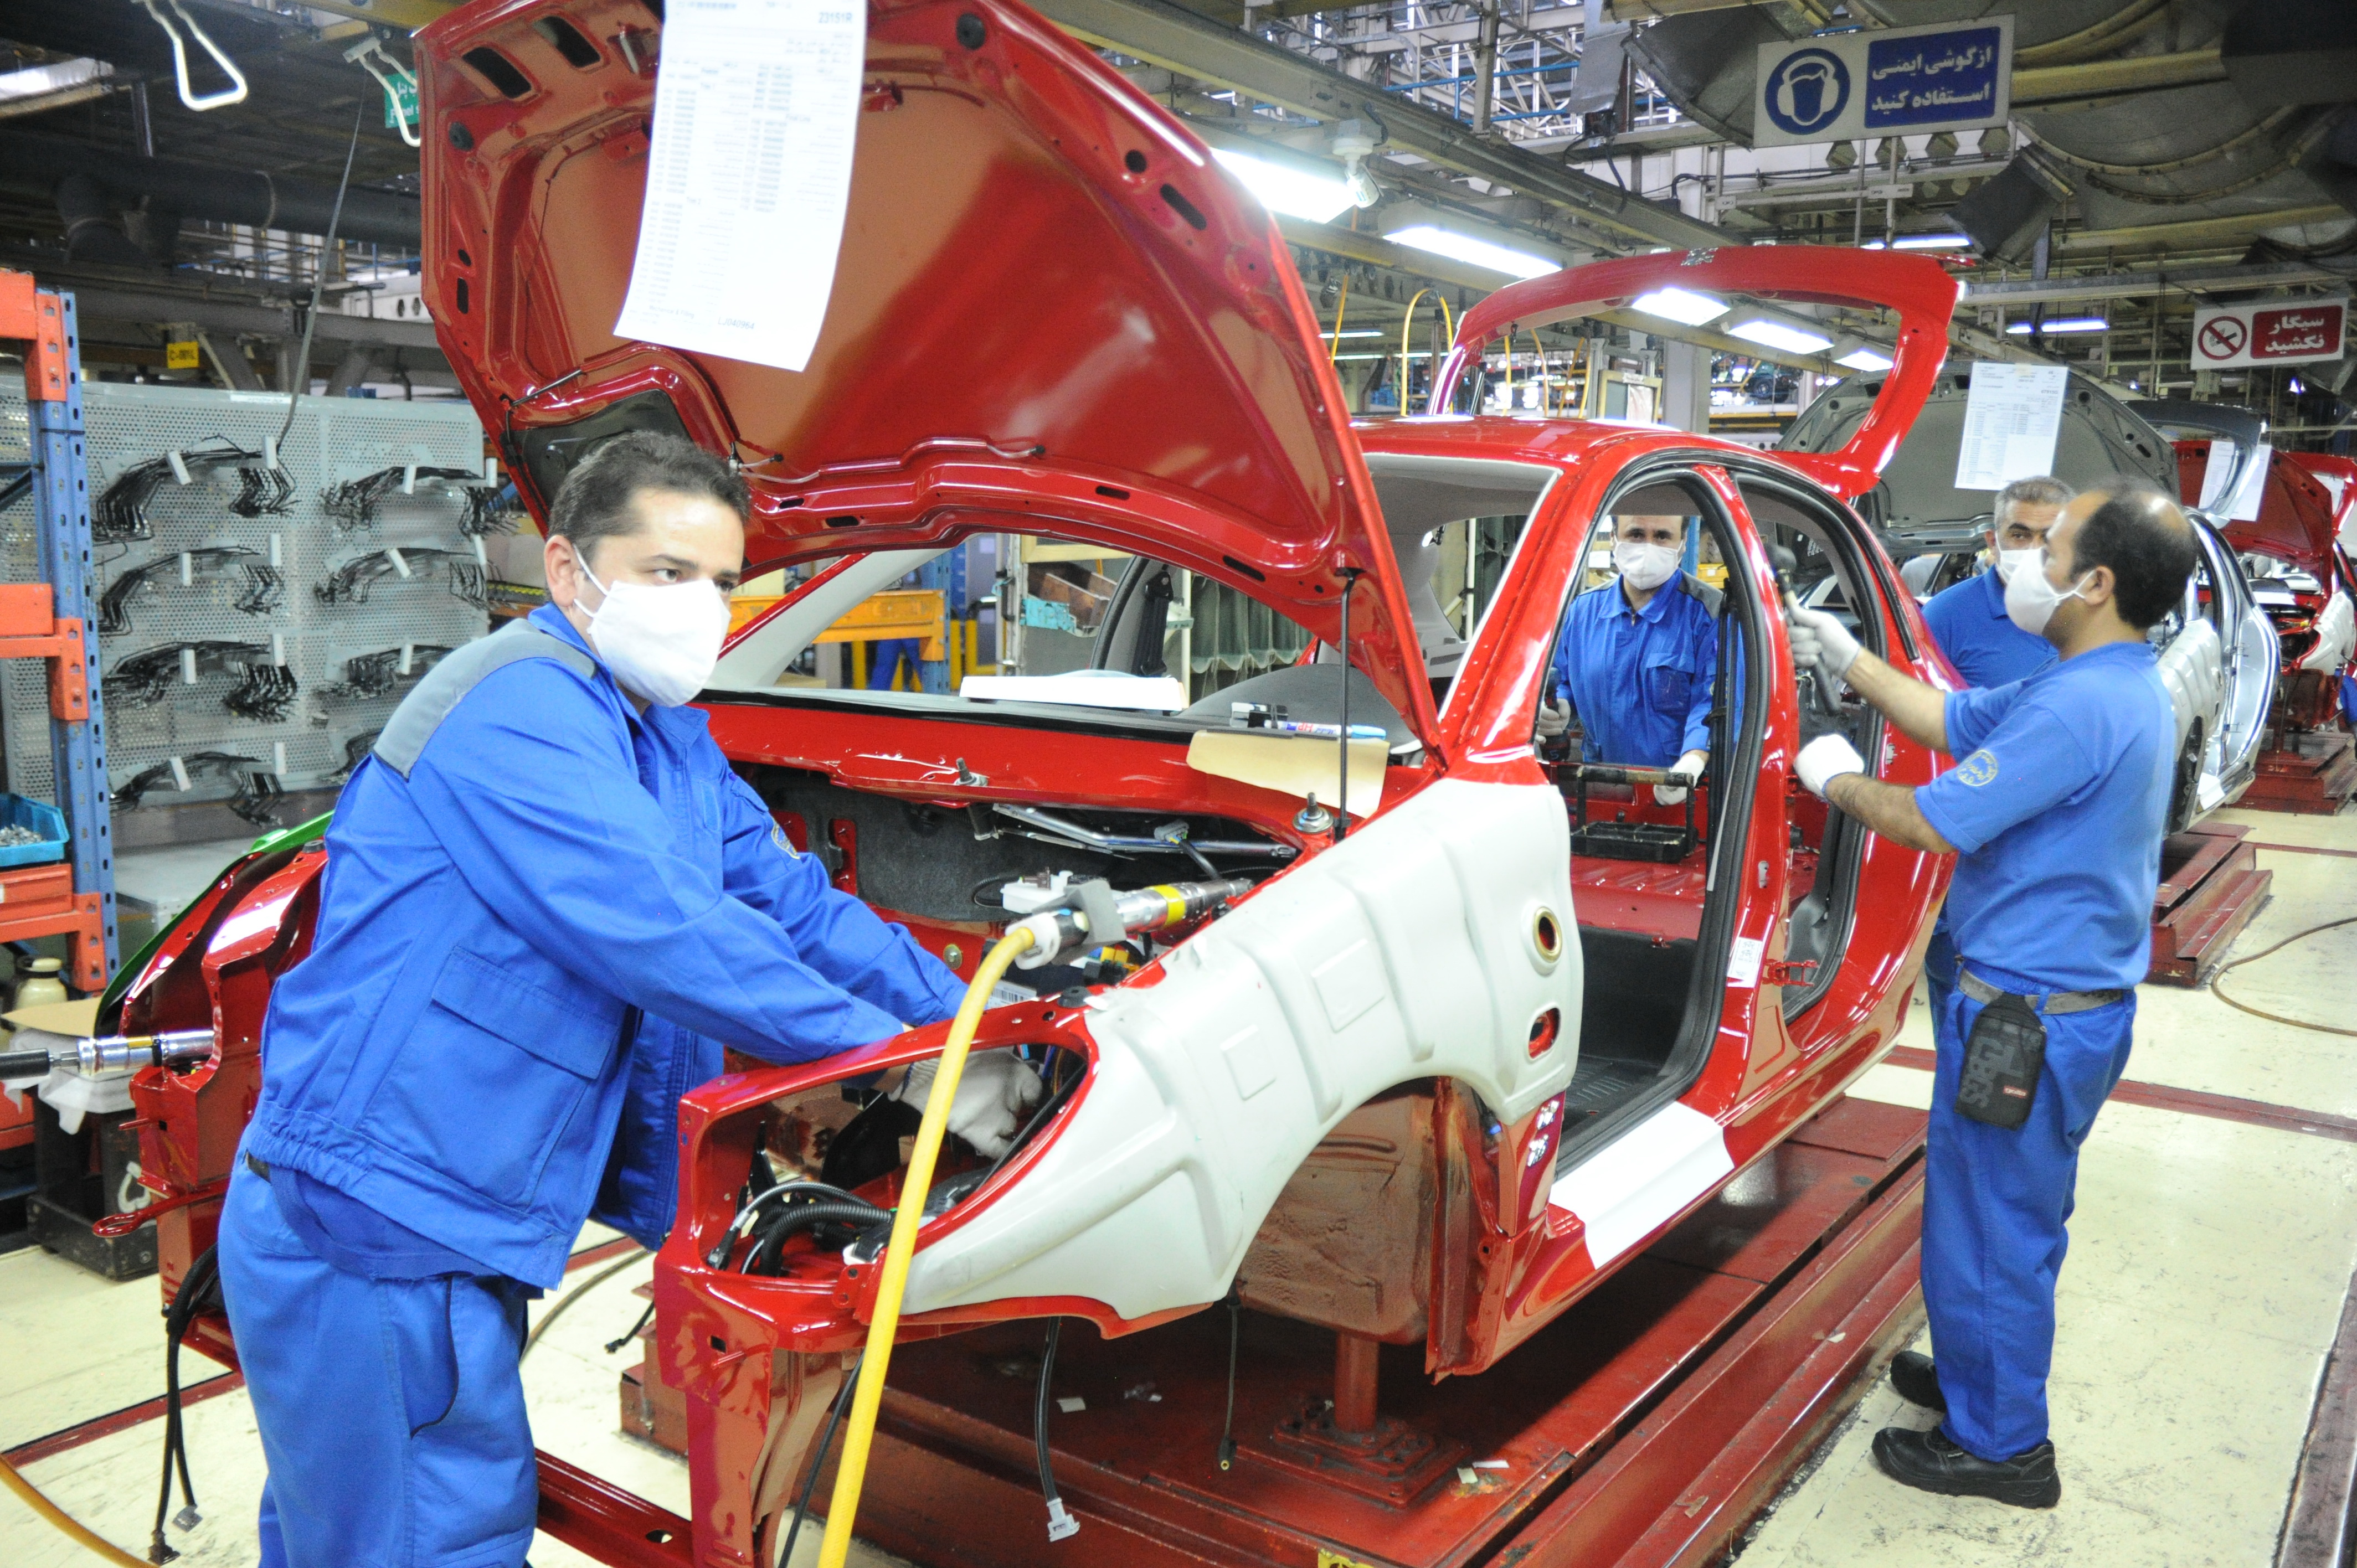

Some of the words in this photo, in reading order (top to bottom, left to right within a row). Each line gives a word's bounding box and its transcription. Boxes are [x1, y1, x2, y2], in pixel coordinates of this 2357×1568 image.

[1871, 53, 1923, 80] ایمنی
[1871, 90, 1910, 115] کنید
[1912, 82, 1990, 108] استفاده
[717, 316, 755, 330] LJ040964
[2268, 314, 2324, 335] سیگار
[2265, 334, 2325, 354] نکشید
